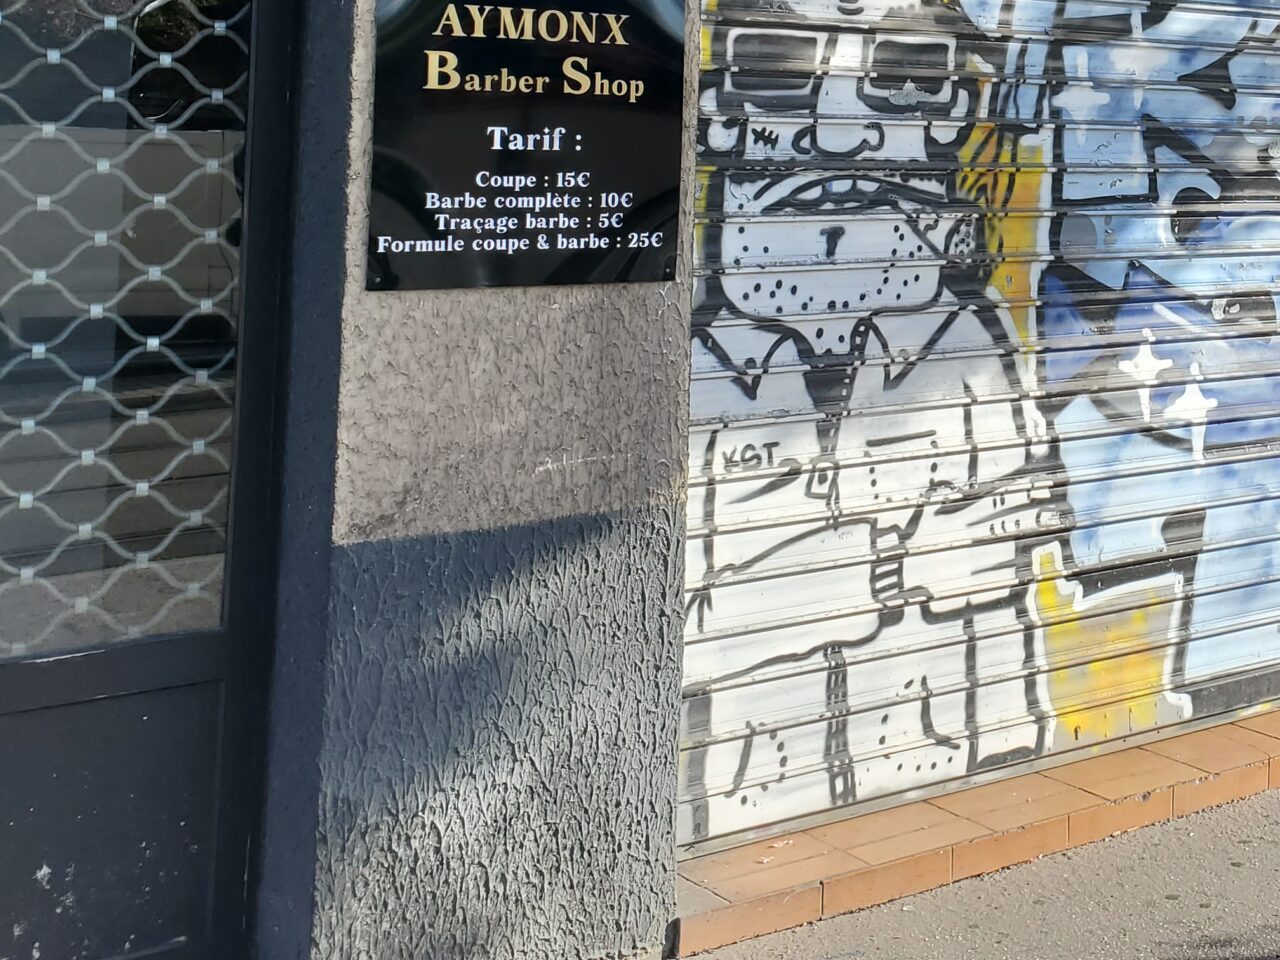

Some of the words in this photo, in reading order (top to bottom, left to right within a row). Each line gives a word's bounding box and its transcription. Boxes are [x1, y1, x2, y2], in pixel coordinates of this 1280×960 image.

[432, 3, 630, 46] AYMONX
[422, 50, 550, 94] Barber
[562, 56, 645, 103] Shop
[487, 126, 566, 151] Tarif
[475, 171, 537, 191] Coupe
[555, 172, 591, 188] 15€
[425, 192, 487, 209] Barbe
[494, 191, 581, 212] complète
[599, 192, 634, 208] 10€
[435, 214, 518, 234] Traçage
[525, 213, 580, 229] barbe
[598, 213, 624, 228] 5€
[377, 236, 465, 253] Formule
[472, 237, 530, 255] coupe
[536, 234, 550, 250] &
[557, 233, 610, 250] barbe
[627, 232, 663, 248] 25€
